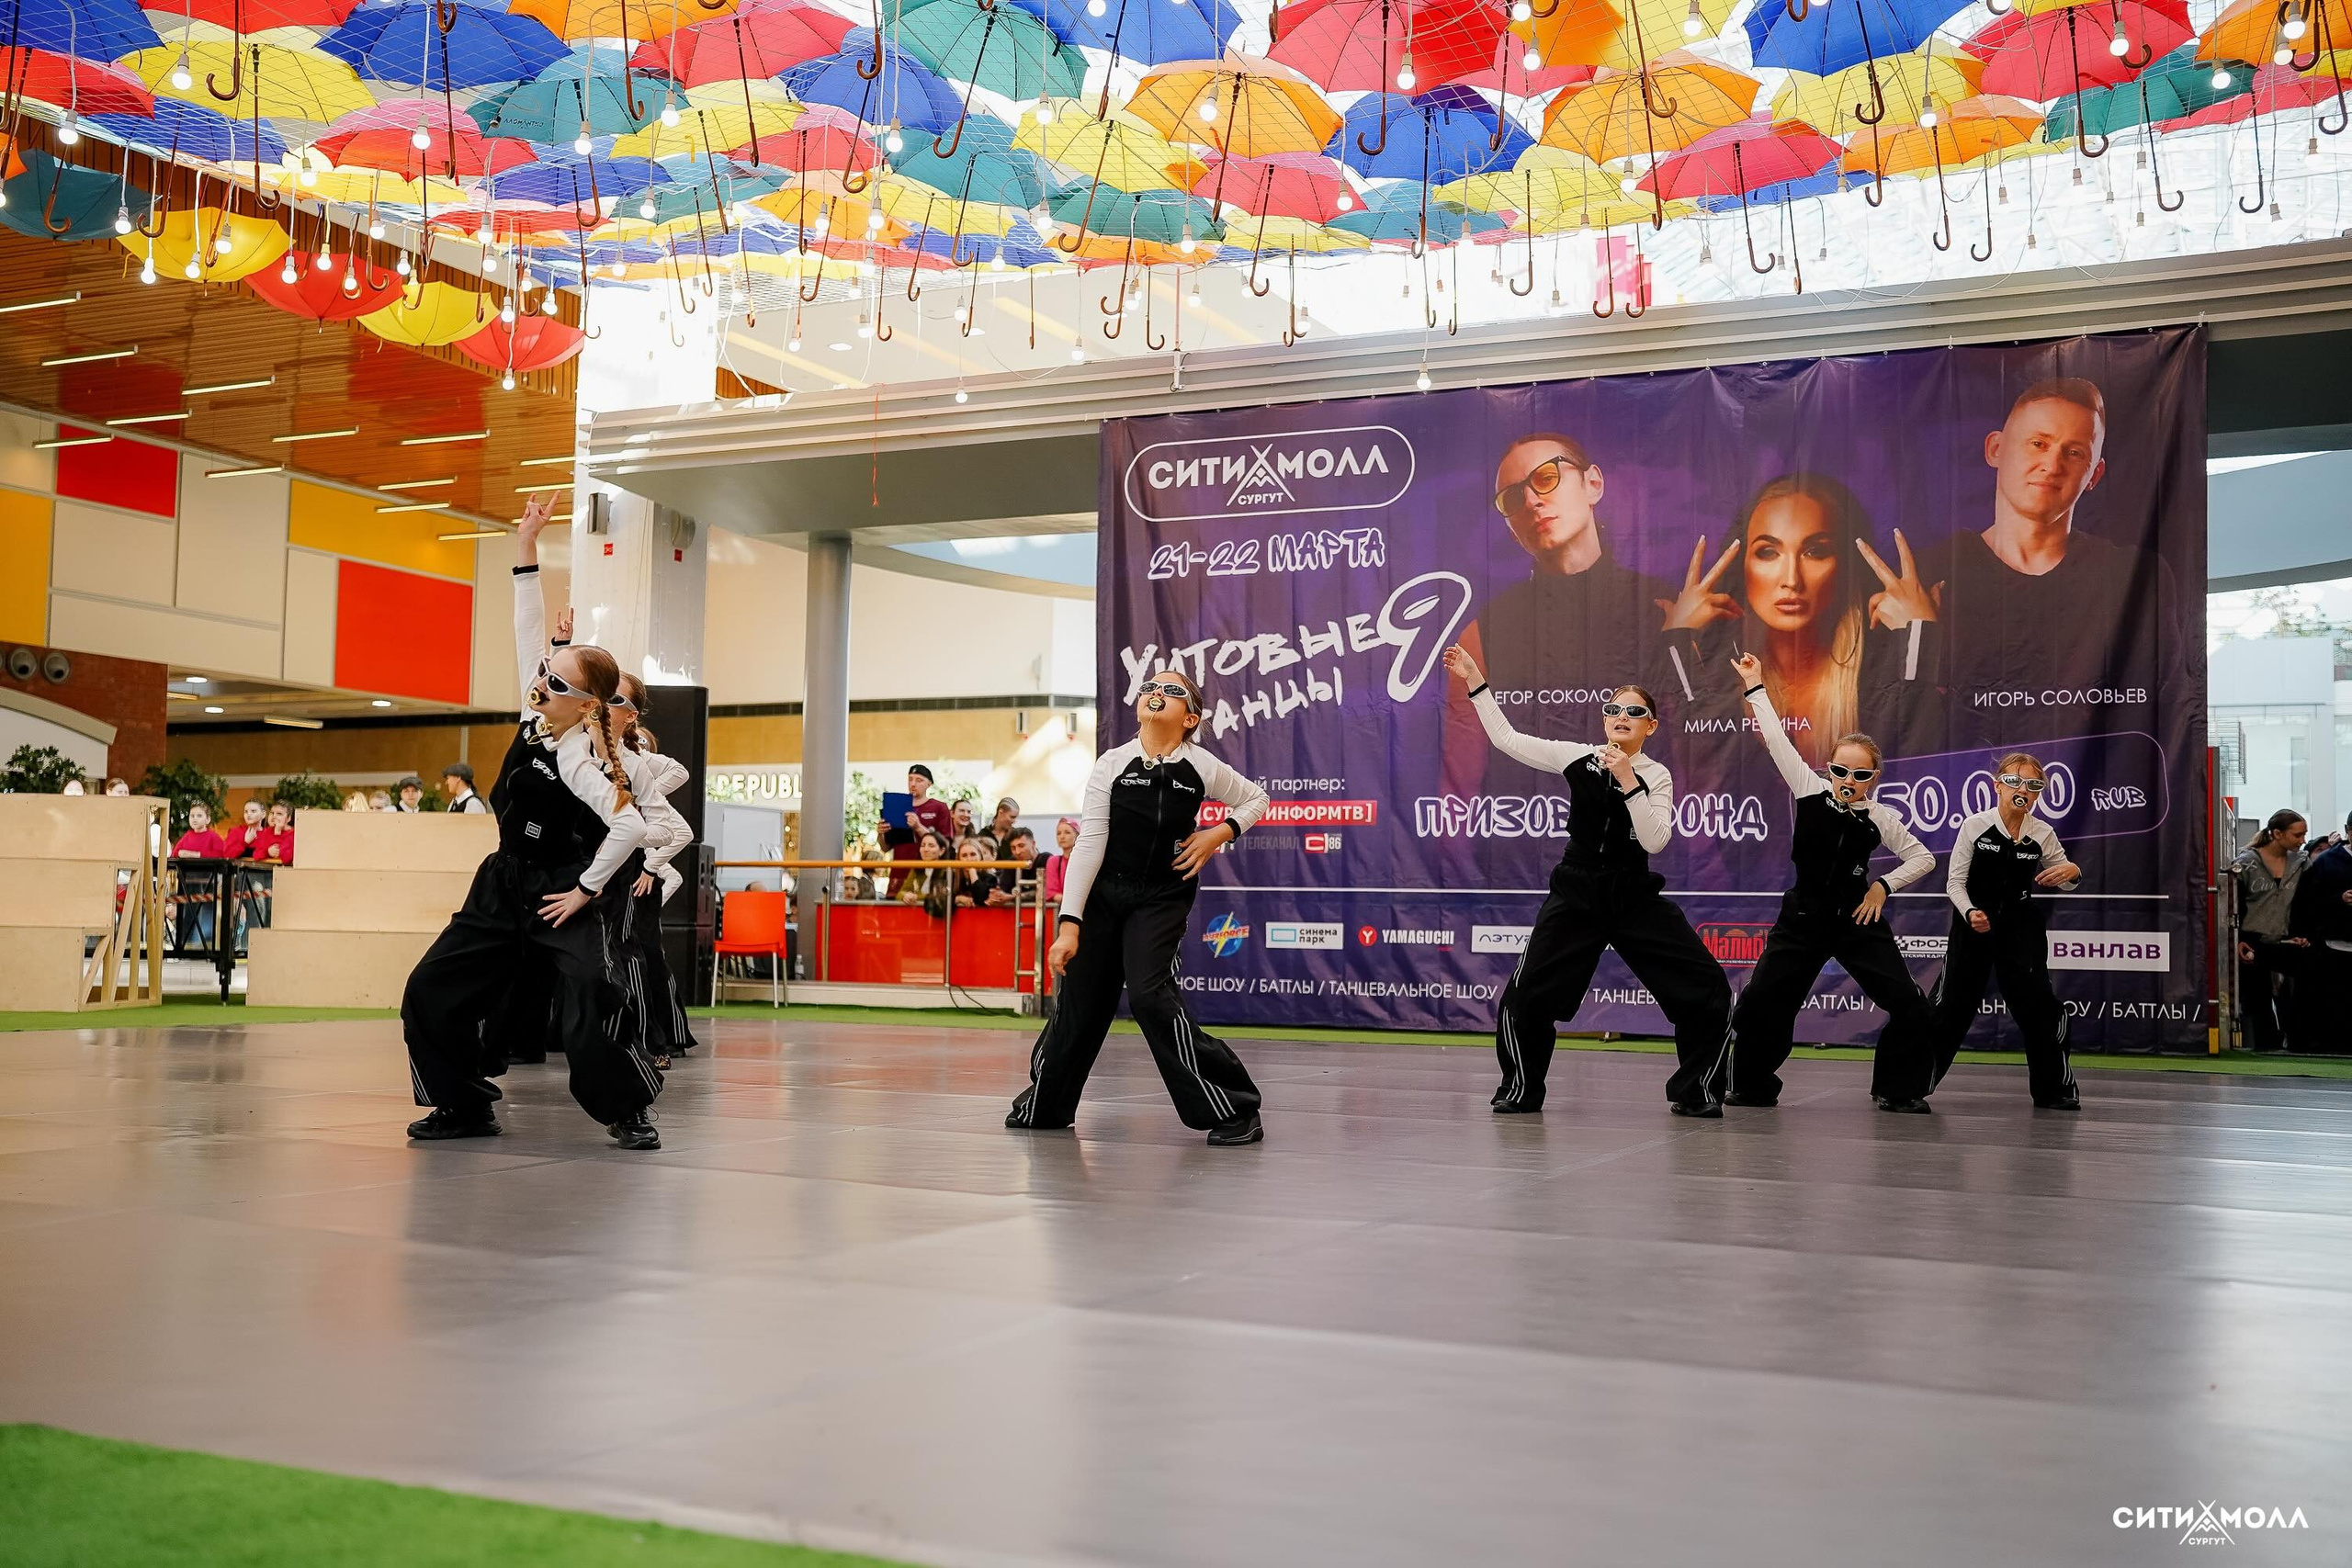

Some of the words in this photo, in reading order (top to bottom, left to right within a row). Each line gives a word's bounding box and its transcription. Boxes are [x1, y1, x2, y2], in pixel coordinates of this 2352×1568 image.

[1148, 456, 1245, 489] СИТИ
[1278, 445, 1389, 479] МОЛЛ
[1238, 492, 1283, 505] СУРГУТ
[1148, 540, 1261, 580] 21-22
[1268, 528, 1385, 572] МАРТА
[1495, 691, 1532, 705] ЕГОР
[1538, 688, 1619, 705] СОКОЛО
[1974, 692, 2035, 707] ИГОРЬ
[2041, 688, 2147, 705] СОЛОВЬЕВ
[1684, 719, 1736, 733] МИЛА
[1742, 716, 1811, 732] РЕИНА
[1272, 777, 1345, 794] партнер:
[1872, 761, 2075, 832] 50.00
[2091, 786, 2146, 810] RUB
[1198, 803, 1372, 823] СУРИНФОРМТВ]
[1415, 794, 1571, 838] ПРИЗОВ
[1671, 793, 1768, 842] ОНД
[1243, 836, 1300, 850] ТЕЛЕКАНАЛ
[1299, 928, 1338, 936] синема
[1299, 936, 1325, 945] парк
[1382, 930, 1454, 944] YAMAGUCHI
[1910, 940, 1948, 948] ФОР
[2053, 942, 2161, 960] ванлав
[1208, 977, 1245, 993] ШОУ
[1260, 978, 1314, 994] БАТТЛЫ
[1329, 980, 1453, 998] ТАНЦЕВАЛЬНОЕ
[1456, 985, 1498, 1000] ШОУ
[1592, 988, 1658, 1006] ТАНЦЕВ
[2064, 1000, 2091, 1017] ОУ
[2113, 1002, 2186, 1020] БАТТЛЫ
